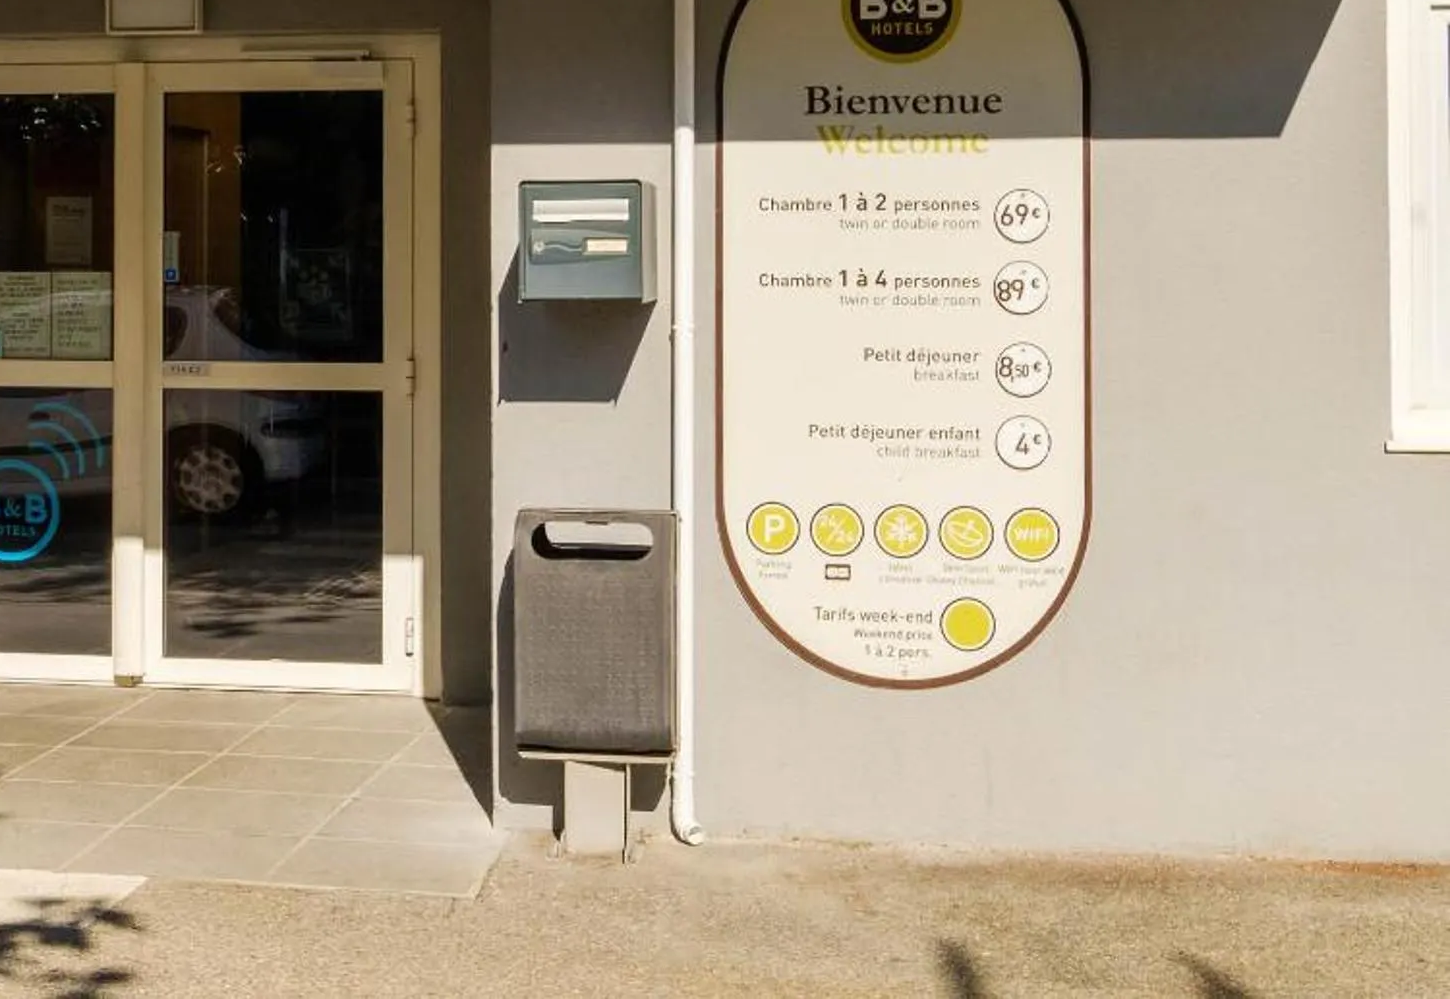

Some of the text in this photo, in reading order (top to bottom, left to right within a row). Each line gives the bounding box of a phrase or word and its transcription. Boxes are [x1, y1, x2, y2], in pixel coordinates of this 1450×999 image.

[871, 22, 934, 36] HOTELS
[804, 85, 1003, 116] Bienvenue
[815, 125, 990, 155] Welcome
[758, 192, 980, 213] Chambre 1 à 2 personnes
[840, 218, 980, 230] twin or double room
[758, 268, 980, 290] Chambre 1 à 4 personnes
[840, 294, 980, 307] twin or double room
[863, 347, 979, 365] Petit déjeuner
[914, 368, 980, 382] breakfast
[808, 424, 980, 442] Petit déjeuner enfant
[876, 445, 980, 459] child breakfast
[763, 513, 786, 543] P
[814, 606, 933, 624] Tarifs week-end
[875, 643, 883, 657] à
[887, 644, 896, 657] 2
